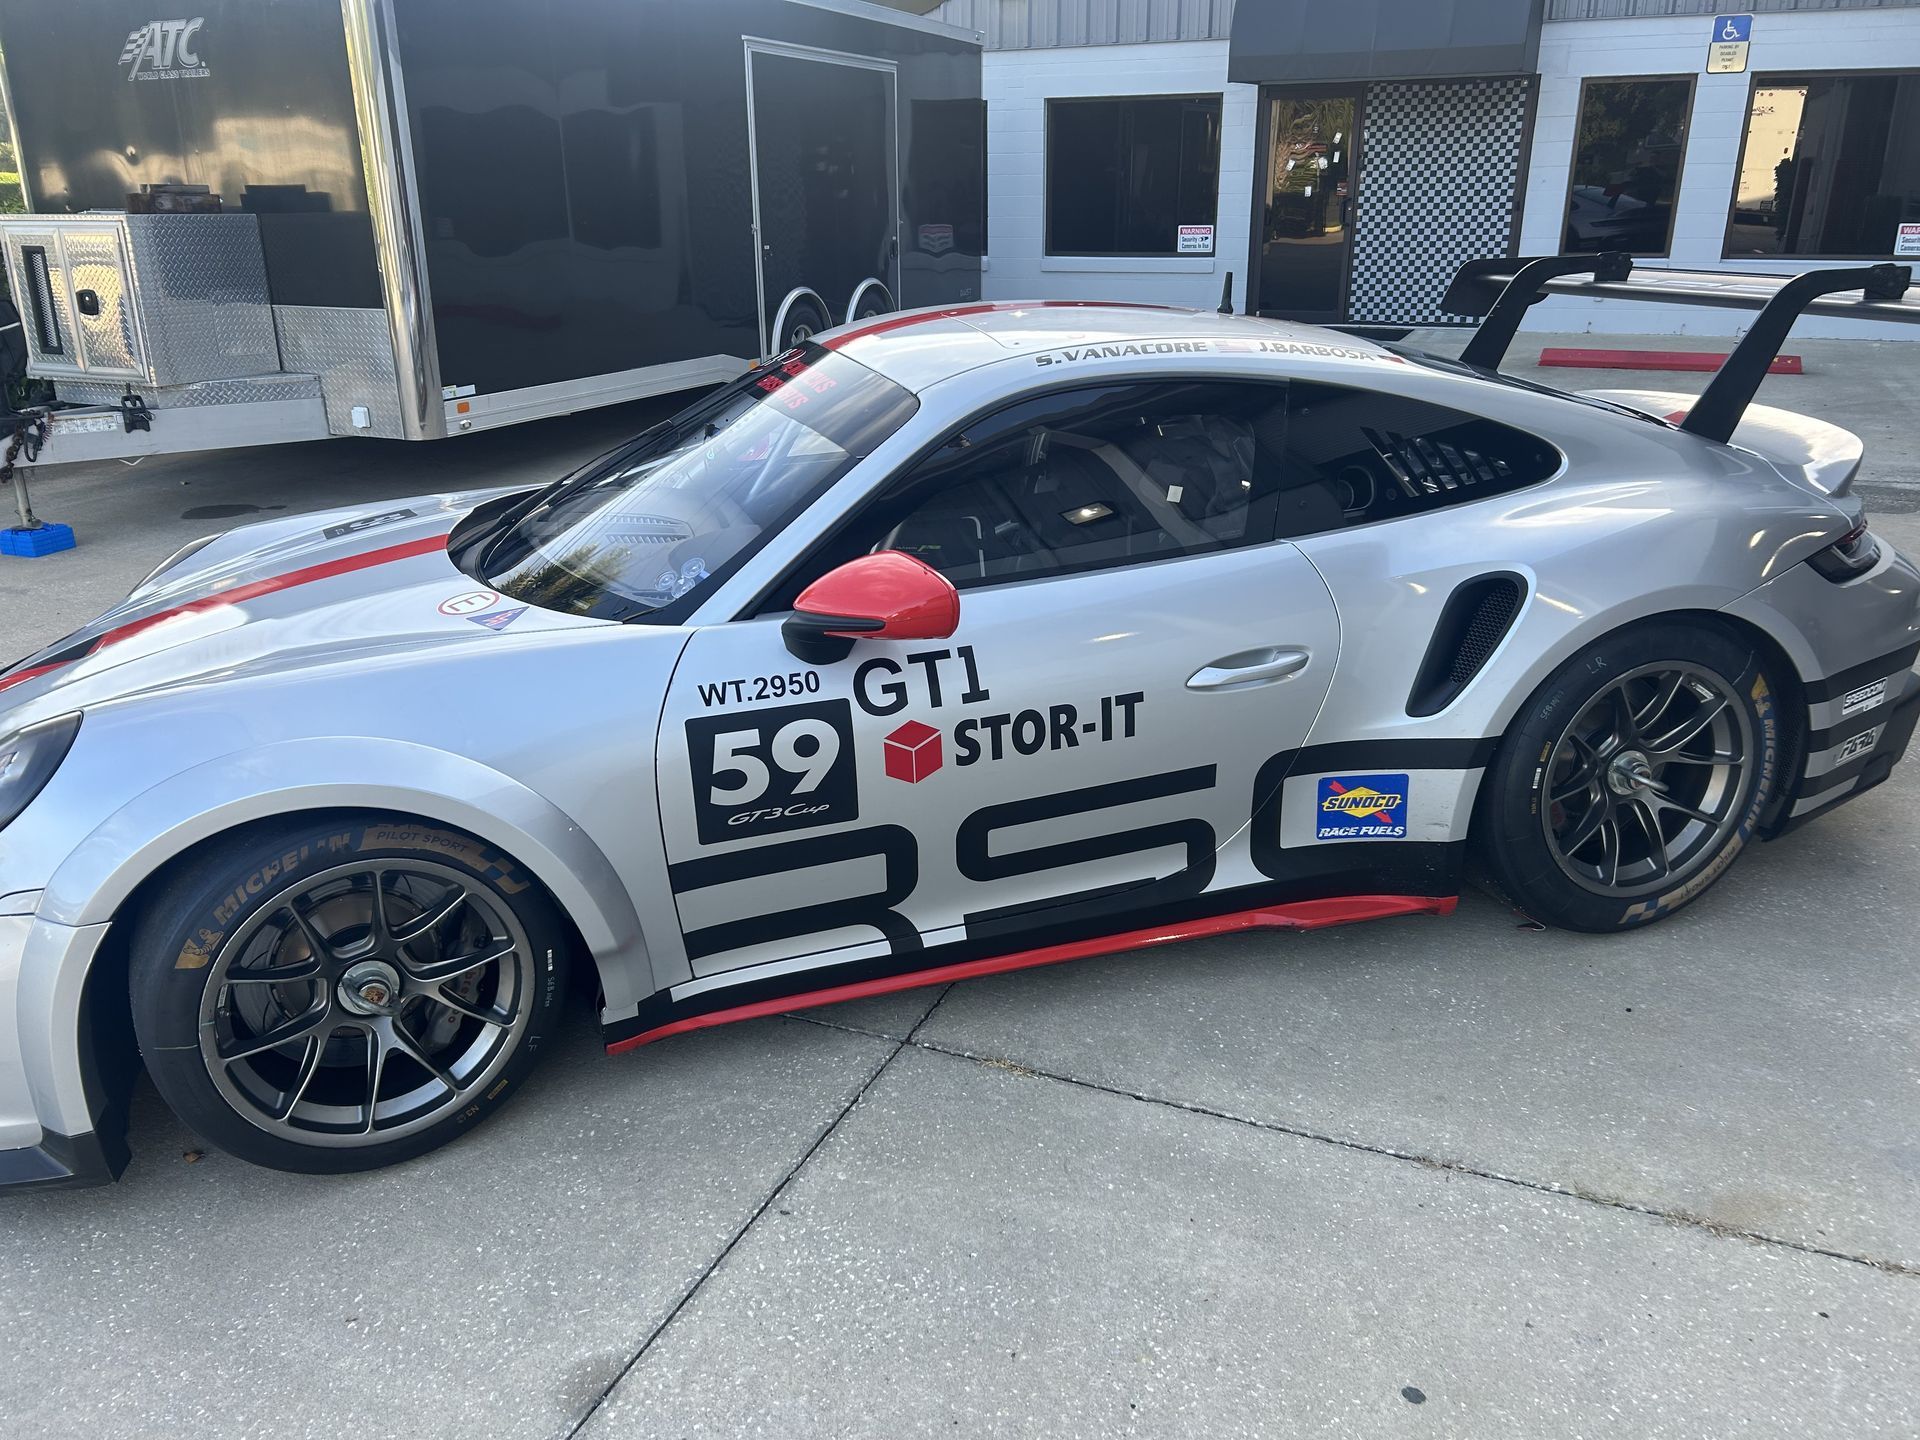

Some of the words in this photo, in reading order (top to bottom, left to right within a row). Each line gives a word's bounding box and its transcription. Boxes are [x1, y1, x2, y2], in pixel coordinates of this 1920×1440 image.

[141, 17, 204, 69] ATC
[159, 69, 180, 79] CLASS
[179, 68, 211, 78] TRAILERS
[1035, 341, 1208, 367] S.VANACORE
[1259, 341, 1375, 361] J.BARBOSA
[697, 669, 820, 707] WT.2950
[853, 645, 990, 717] GT1
[954, 691, 1145, 767] STOR-IT
[709, 718, 841, 806] 59
[1745, 718, 1776, 834] MICHELIN
[1325, 795, 1399, 810] SUNOCO
[376, 831, 420, 840] PILOT
[422, 834, 468, 852] SPORT
[1318, 826, 1359, 837] RACE
[1359, 825, 1405, 836] FUELS
